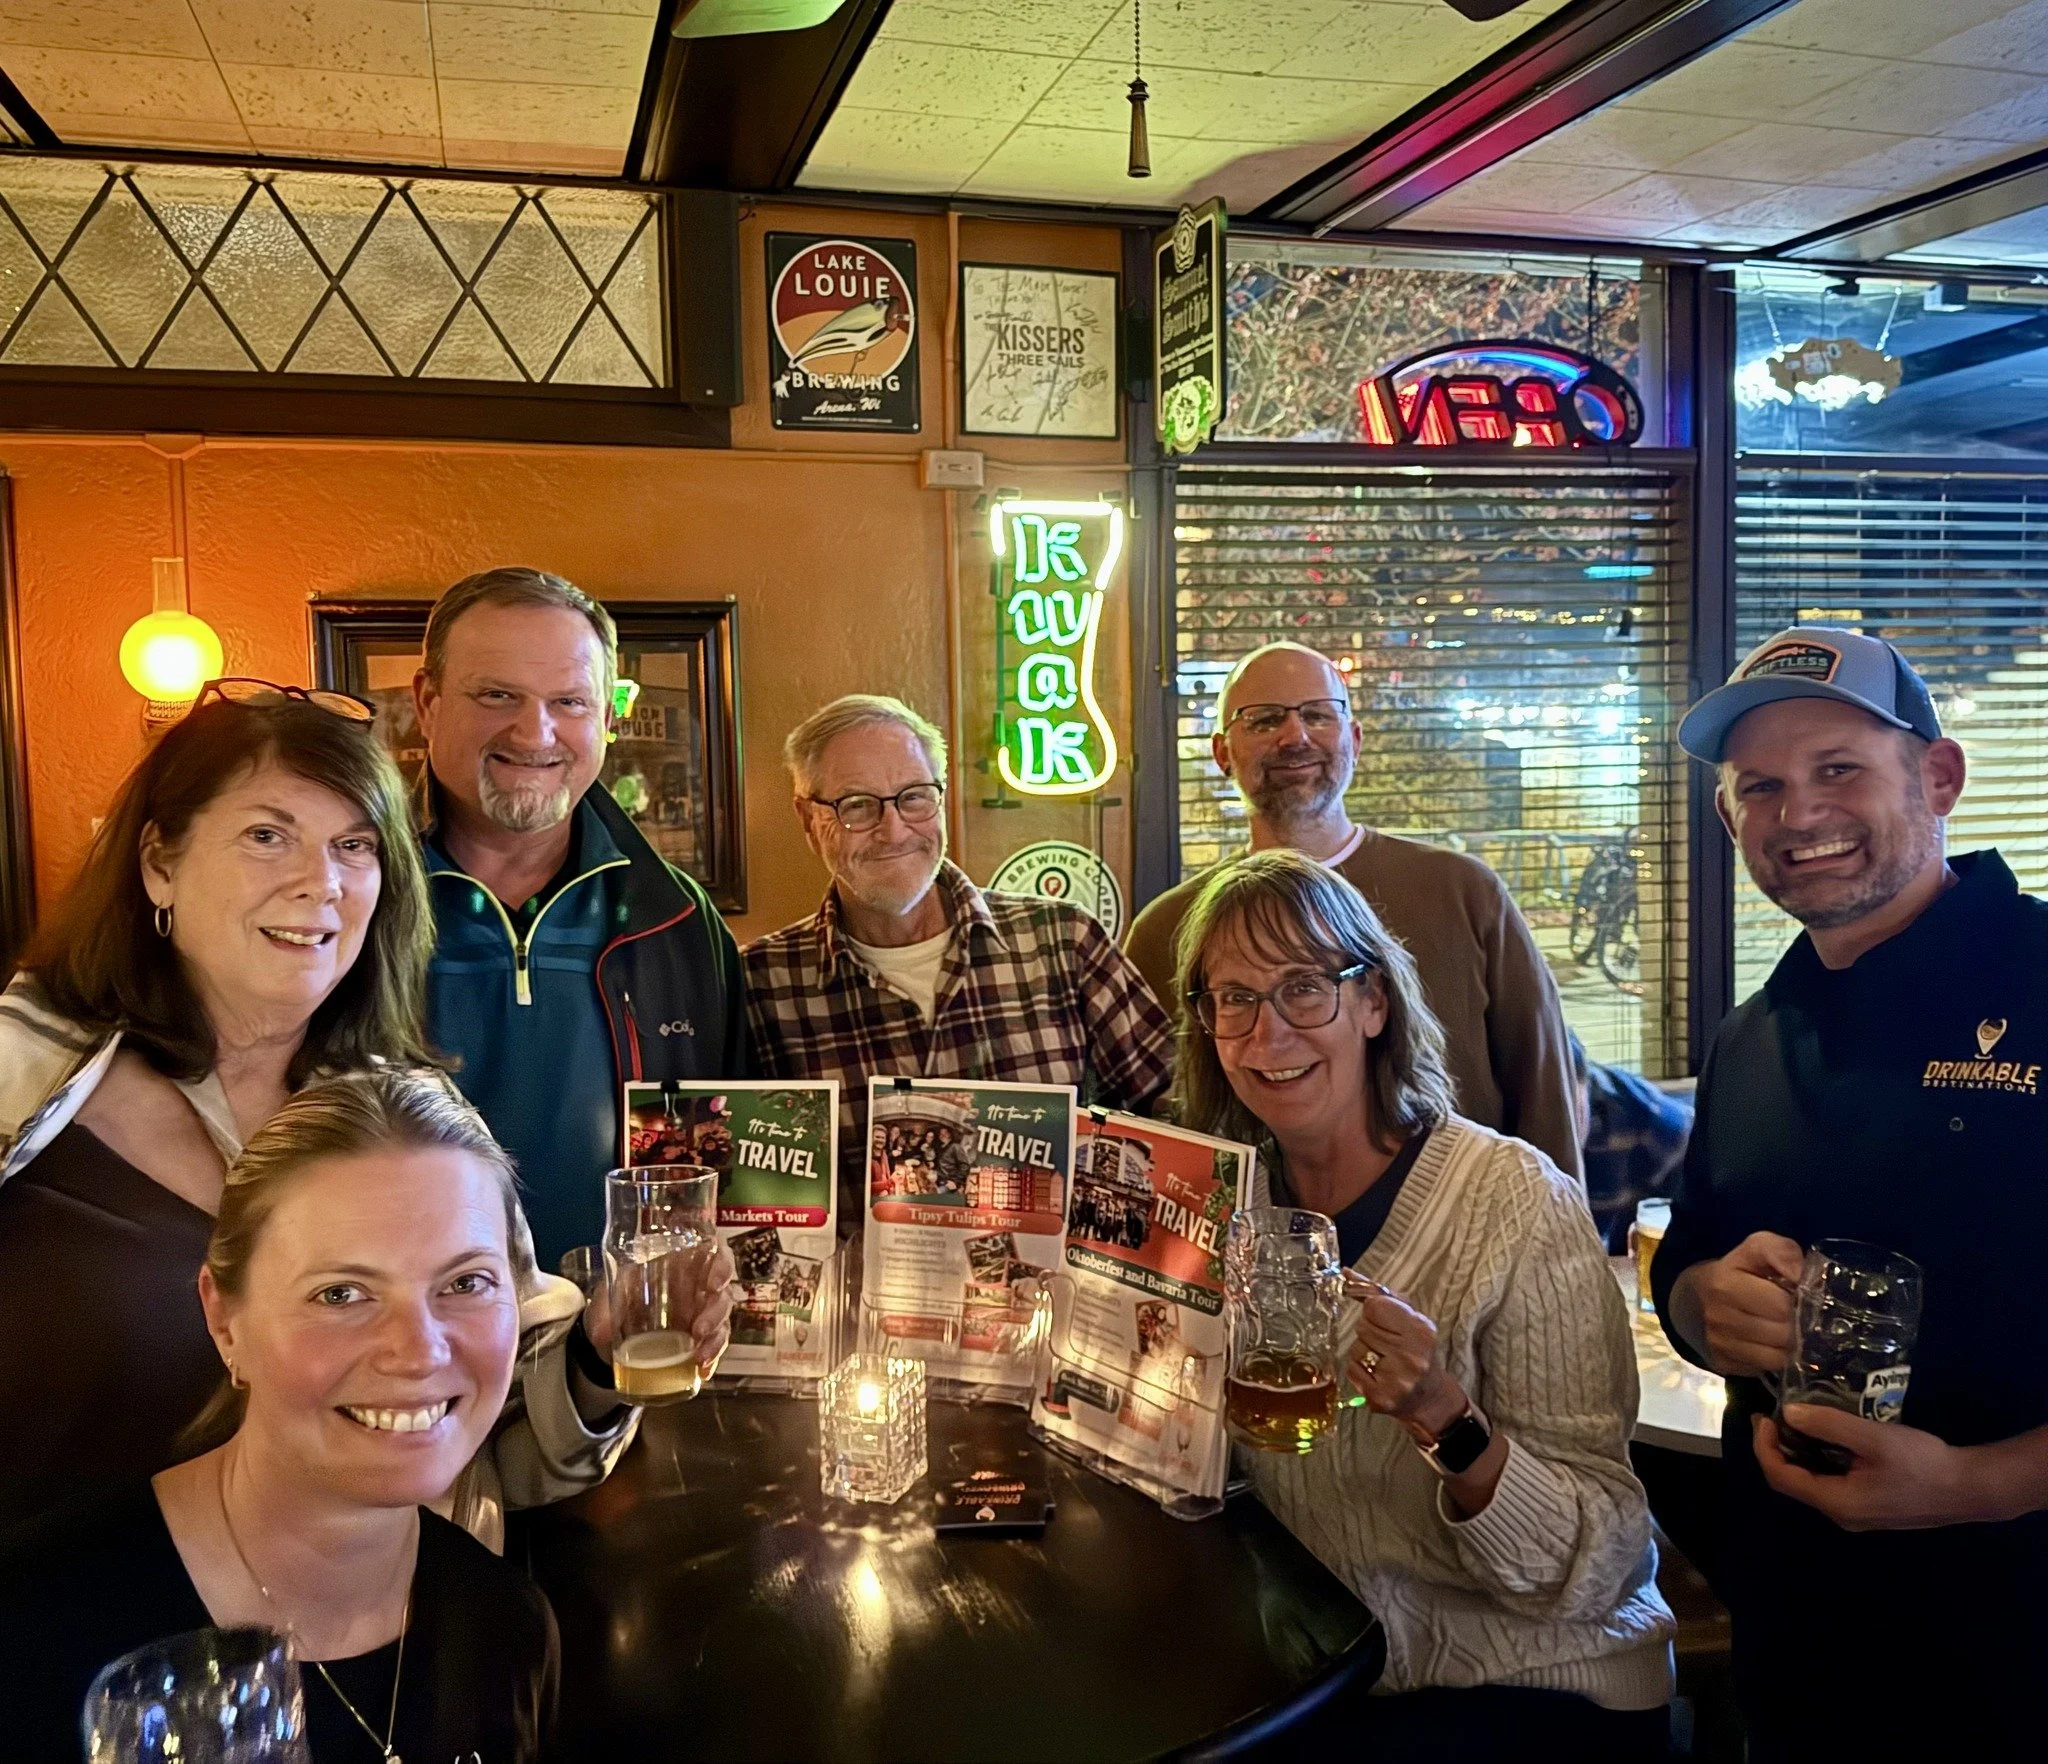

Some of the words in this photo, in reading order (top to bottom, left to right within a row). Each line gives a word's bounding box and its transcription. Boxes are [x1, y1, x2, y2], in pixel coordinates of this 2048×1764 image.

[814, 253, 867, 271] LAKE
[795, 272, 890, 299] LOUIE
[997, 323, 1086, 355] KISSERS
[997, 352, 1044, 367] THREE
[1047, 356, 1085, 369] SAILS
[792, 371, 900, 391] BREWING
[1007, 853, 1079, 883] BREWING
[1923, 1061, 2041, 1086] DRINKABLE
[1922, 1080, 2036, 1095] DESTINATIONS
[738, 1139, 818, 1179] TRAVEL
[977, 1125, 1055, 1170] TRAVEL
[721, 1209, 773, 1223] Markets
[775, 1210, 809, 1223] Tour
[909, 1207, 943, 1222] Tipsy
[946, 1211, 986, 1226] Tulips
[989, 1213, 1022, 1227] Tour
[1154, 1192, 1220, 1257] TRAVEL
[1067, 1248, 1124, 1277] Oktoberfest
[1125, 1270, 1145, 1285] and
[1147, 1274, 1187, 1300] Bavaria
[1188, 1288, 1219, 1310] Tour
